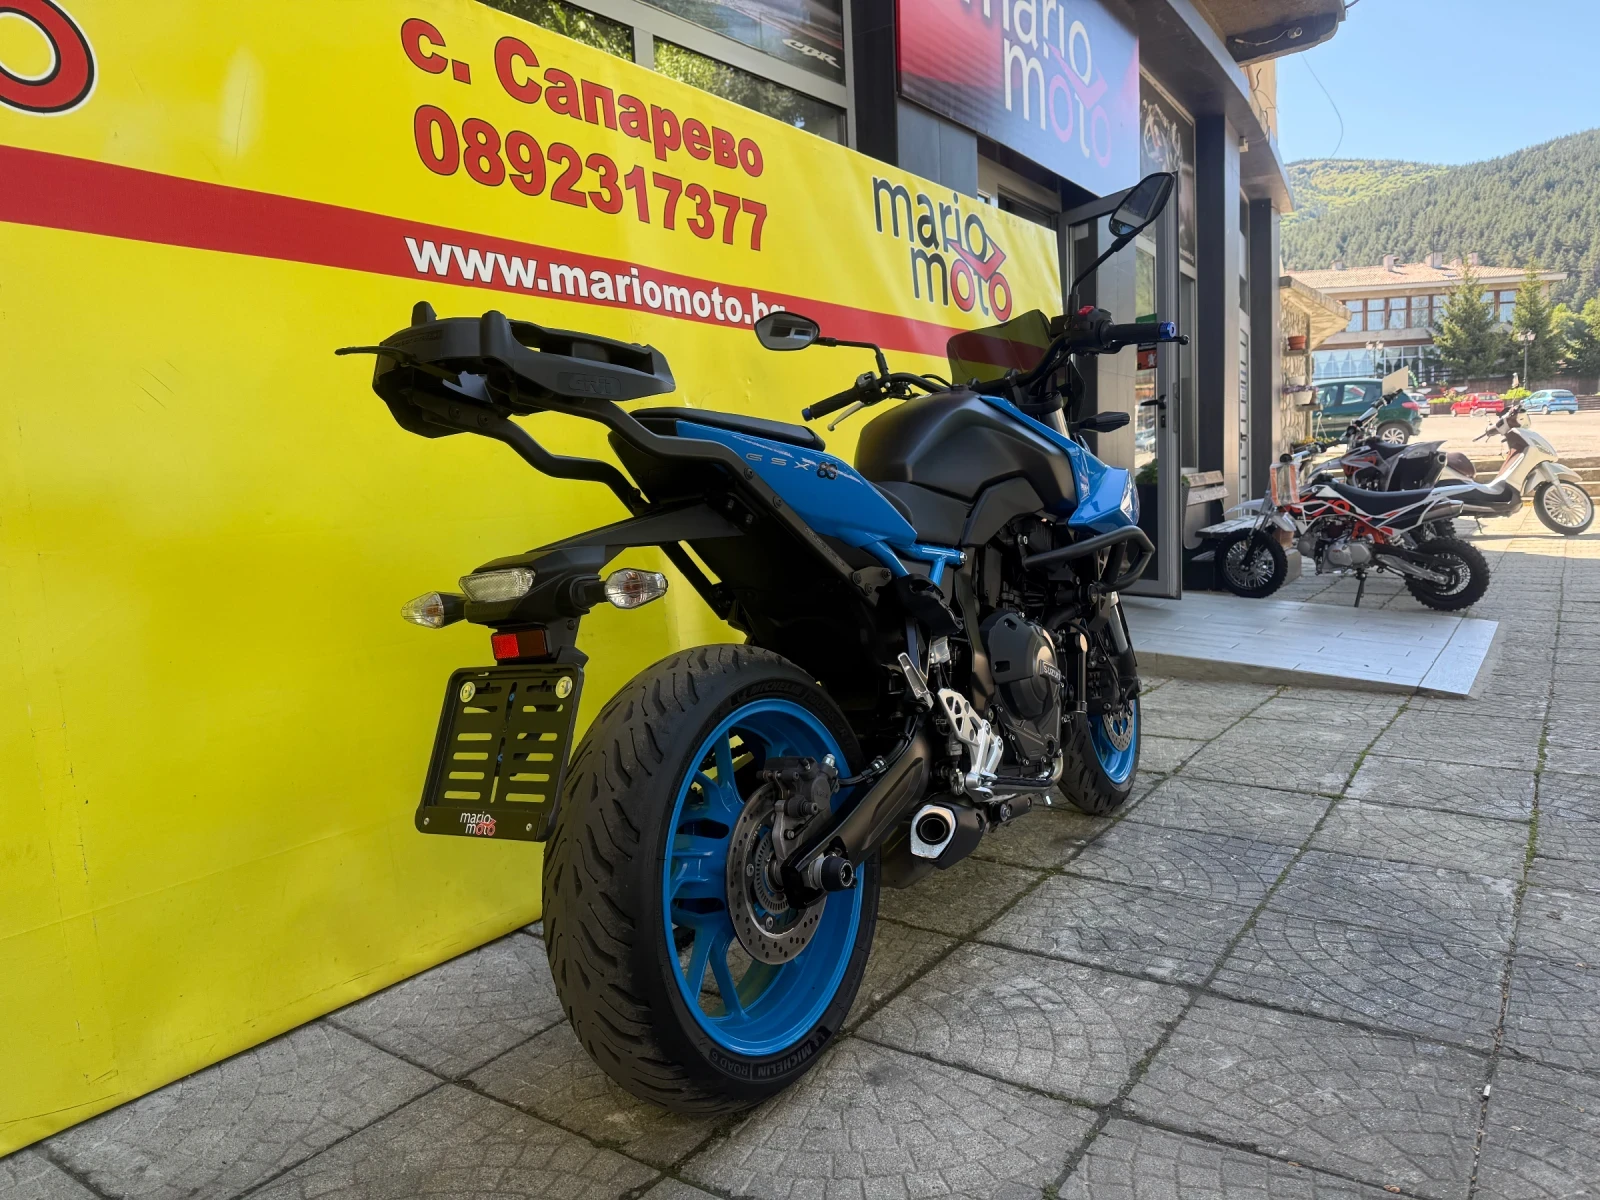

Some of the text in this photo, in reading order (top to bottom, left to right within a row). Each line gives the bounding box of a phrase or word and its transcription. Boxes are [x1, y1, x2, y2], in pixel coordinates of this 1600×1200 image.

[782, 39, 841, 69] CBR
[493, 36, 764, 178] Сапарево
[1003, 37, 1112, 169] moto
[413, 104, 768, 252] 0892317377
[872, 176, 988, 262] mario
[403, 236, 786, 325] www.mariomoto.b
[910, 246, 1013, 323] moto
[460, 811, 491, 824] mario
[465, 823, 496, 836] moto
[720, 1057, 750, 1076] ROAD
[757, 1045, 813, 1077] MICHELIN
